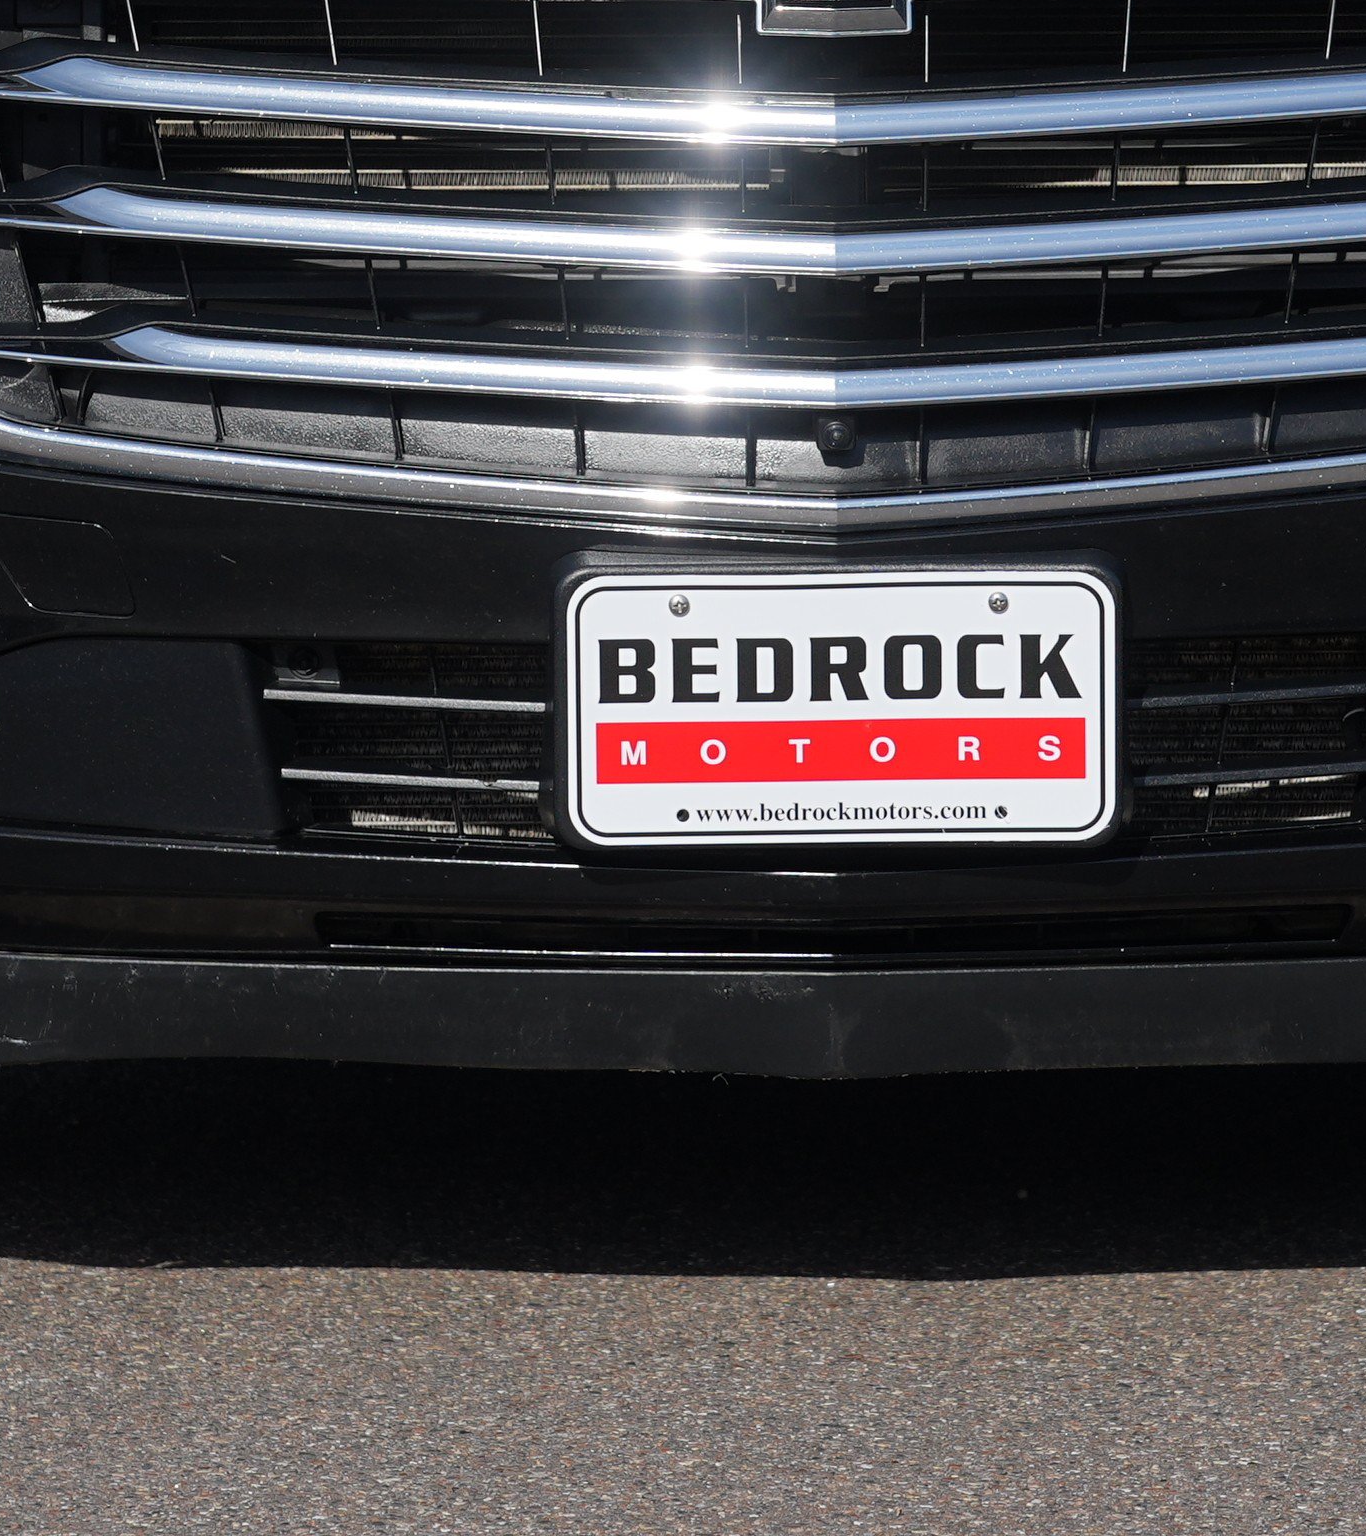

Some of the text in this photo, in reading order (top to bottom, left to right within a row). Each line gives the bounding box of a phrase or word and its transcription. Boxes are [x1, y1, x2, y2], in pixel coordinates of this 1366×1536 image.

[598, 634, 1082, 704] BEDROCK
[620, 735, 1062, 766] MOTORS
[696, 801, 987, 824] www.bedrockmotors.com
